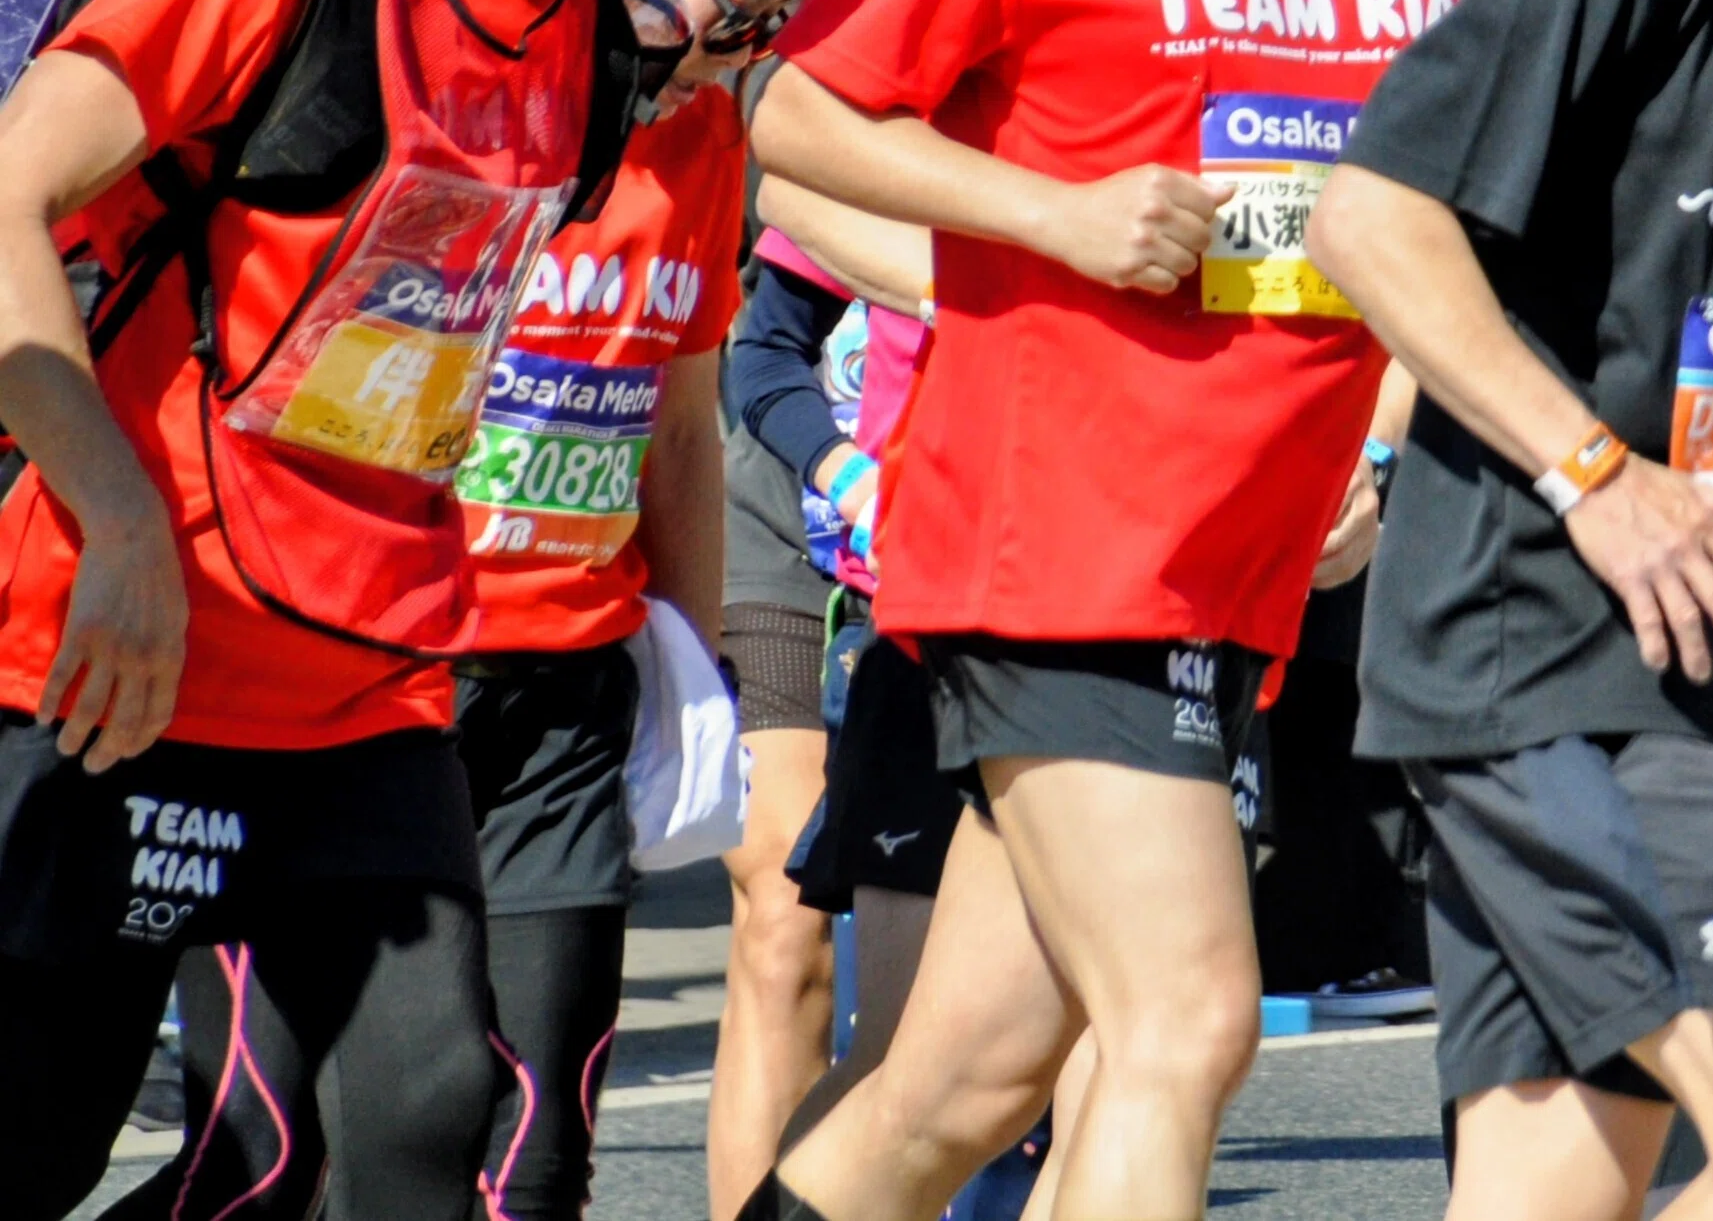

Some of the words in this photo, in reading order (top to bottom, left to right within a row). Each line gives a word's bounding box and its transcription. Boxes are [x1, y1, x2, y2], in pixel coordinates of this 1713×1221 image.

[1227, 108, 1341, 152] Osaka
[516, 252, 621, 316] AM
[487, 362, 597, 412] Osaka
[124, 795, 242, 852] TEAM
[131, 846, 219, 898] KIAI
